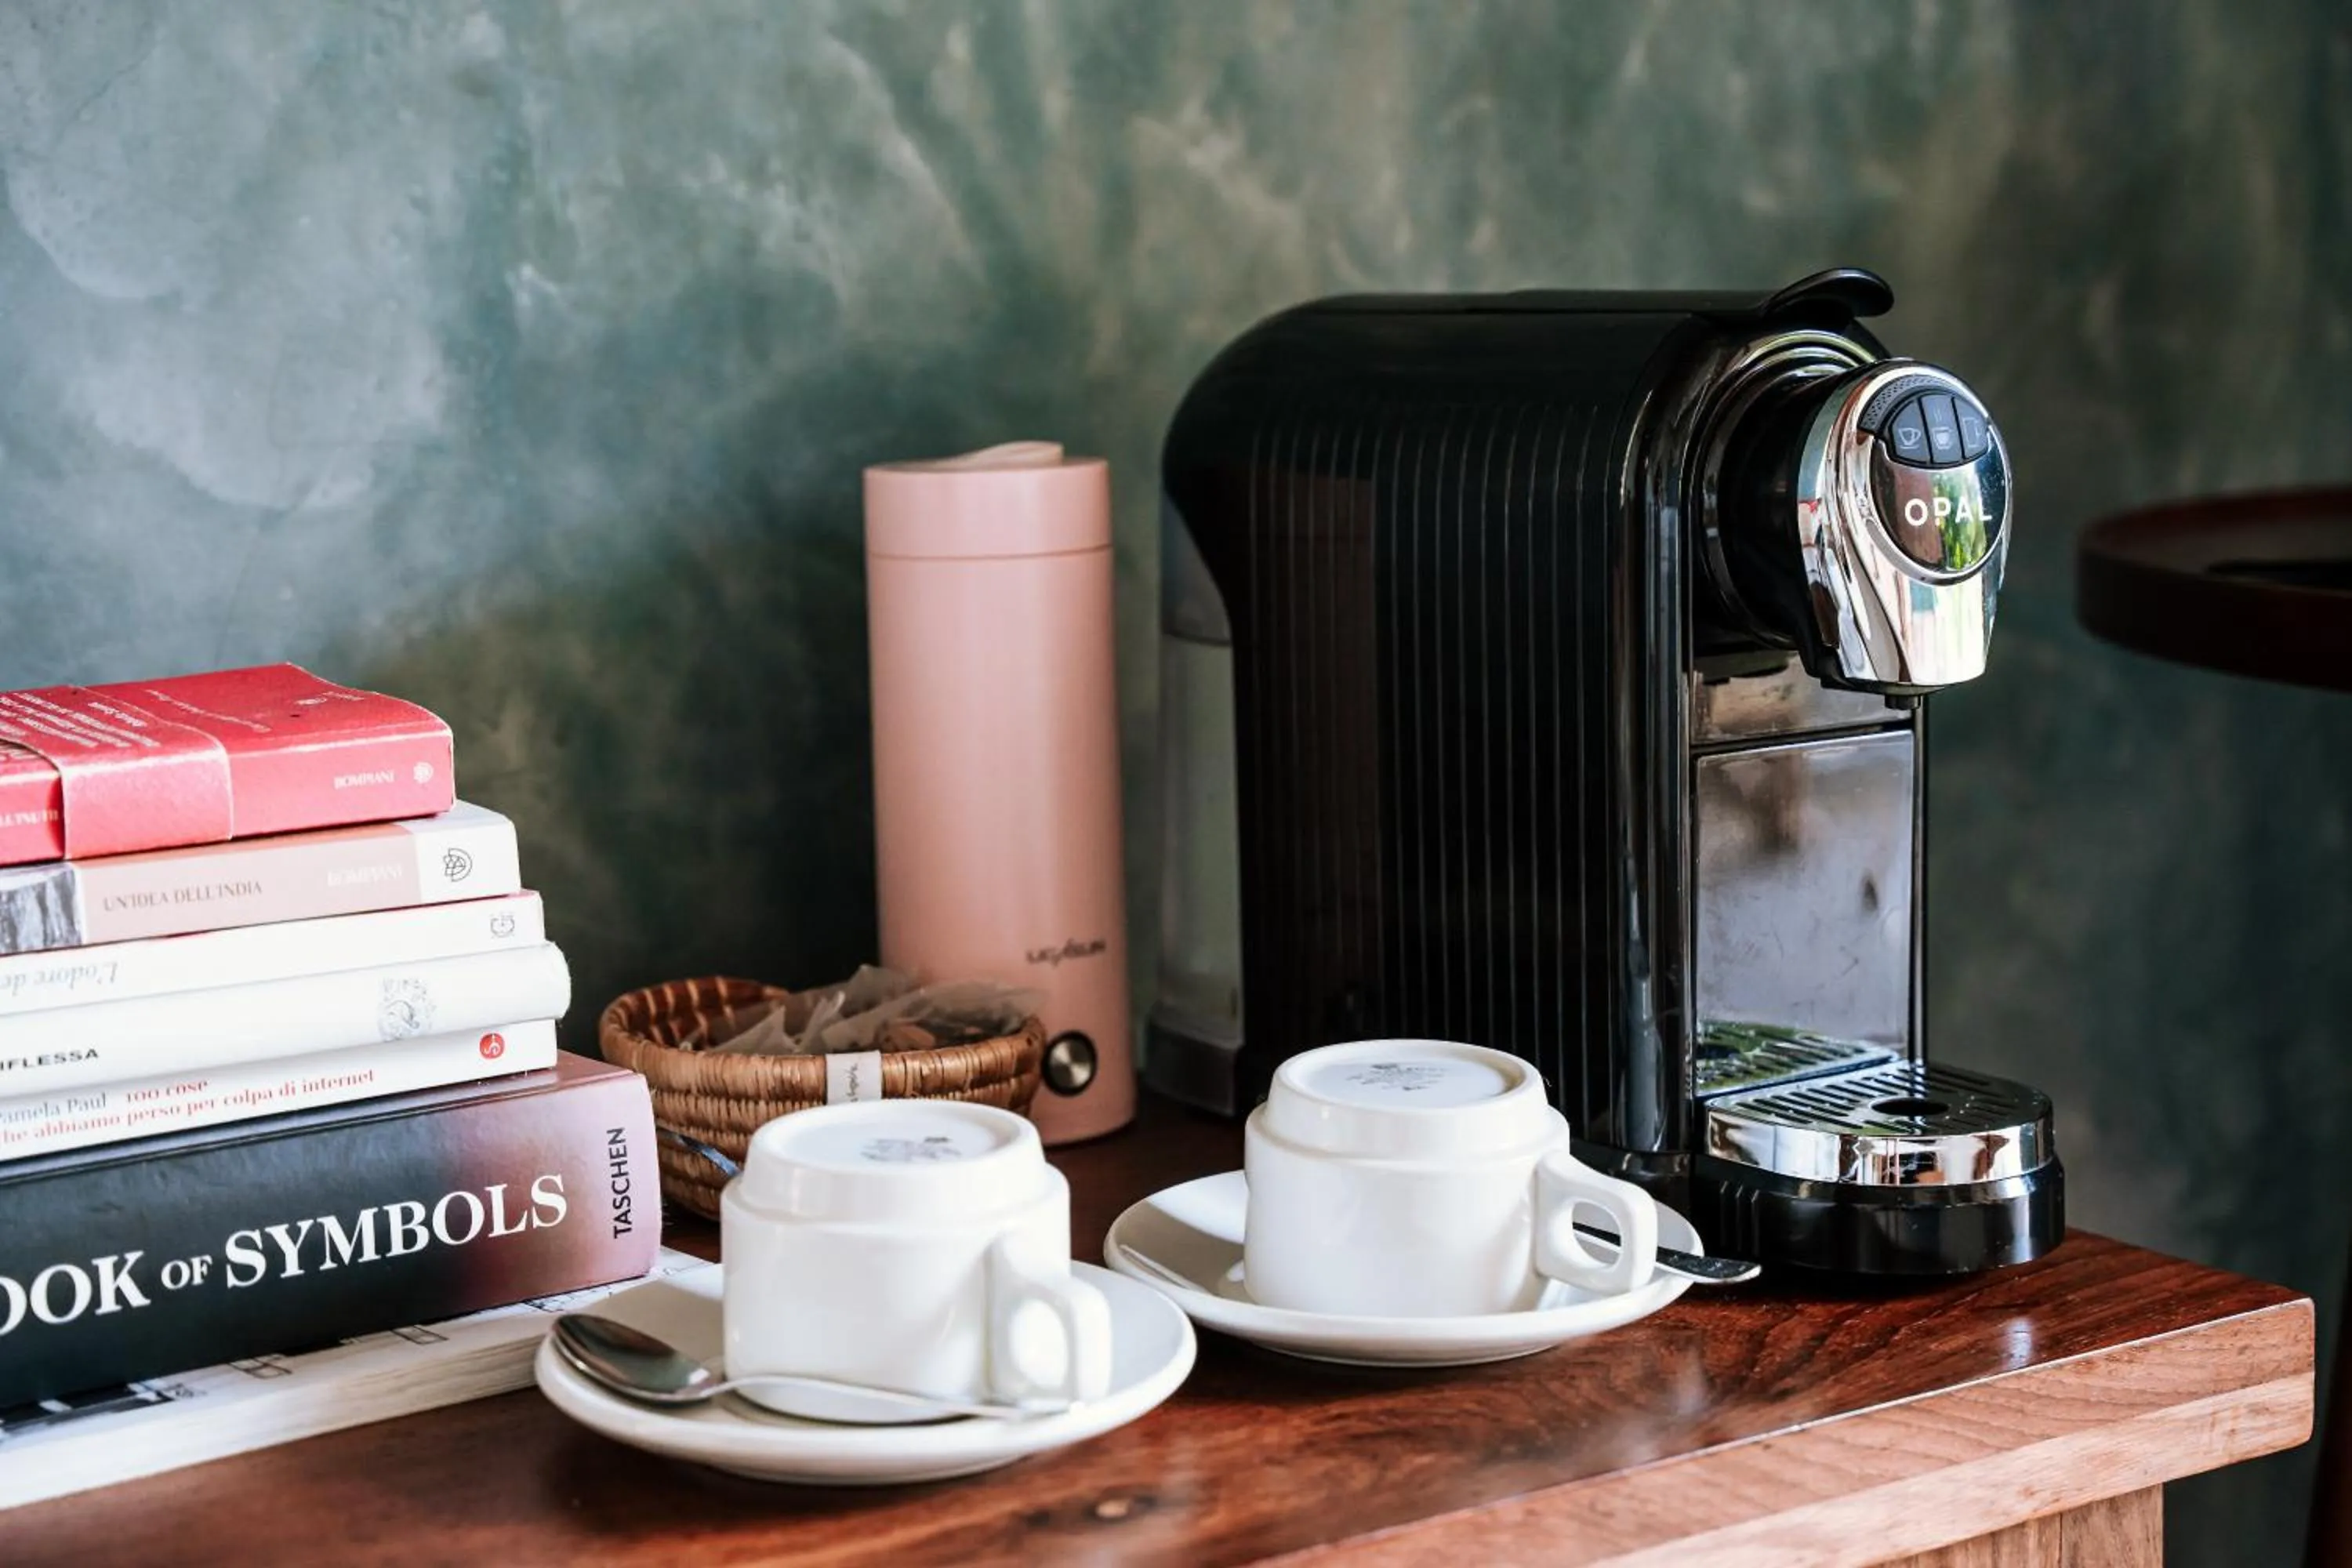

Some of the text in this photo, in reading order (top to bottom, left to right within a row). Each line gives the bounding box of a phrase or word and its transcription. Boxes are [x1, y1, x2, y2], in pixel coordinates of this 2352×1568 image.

[1904, 496, 1993, 527] OPAL
[174, 880, 263, 904] DELL'INDIA
[0, 1101, 60, 1125] amela
[67, 1092, 107, 1114] Paul
[166, 1080, 209, 1096] cose
[34, 1116, 120, 1139] abbiamo
[127, 1105, 180, 1127] perso
[187, 1098, 215, 1116] per
[223, 1087, 273, 1106] colpa
[278, 1080, 297, 1097] di
[303, 1069, 375, 1093] internet
[606, 1127, 633, 1240] TASCHEN
[161, 1254, 213, 1290] OF
[225, 1173, 568, 1288] SYMBOLS
